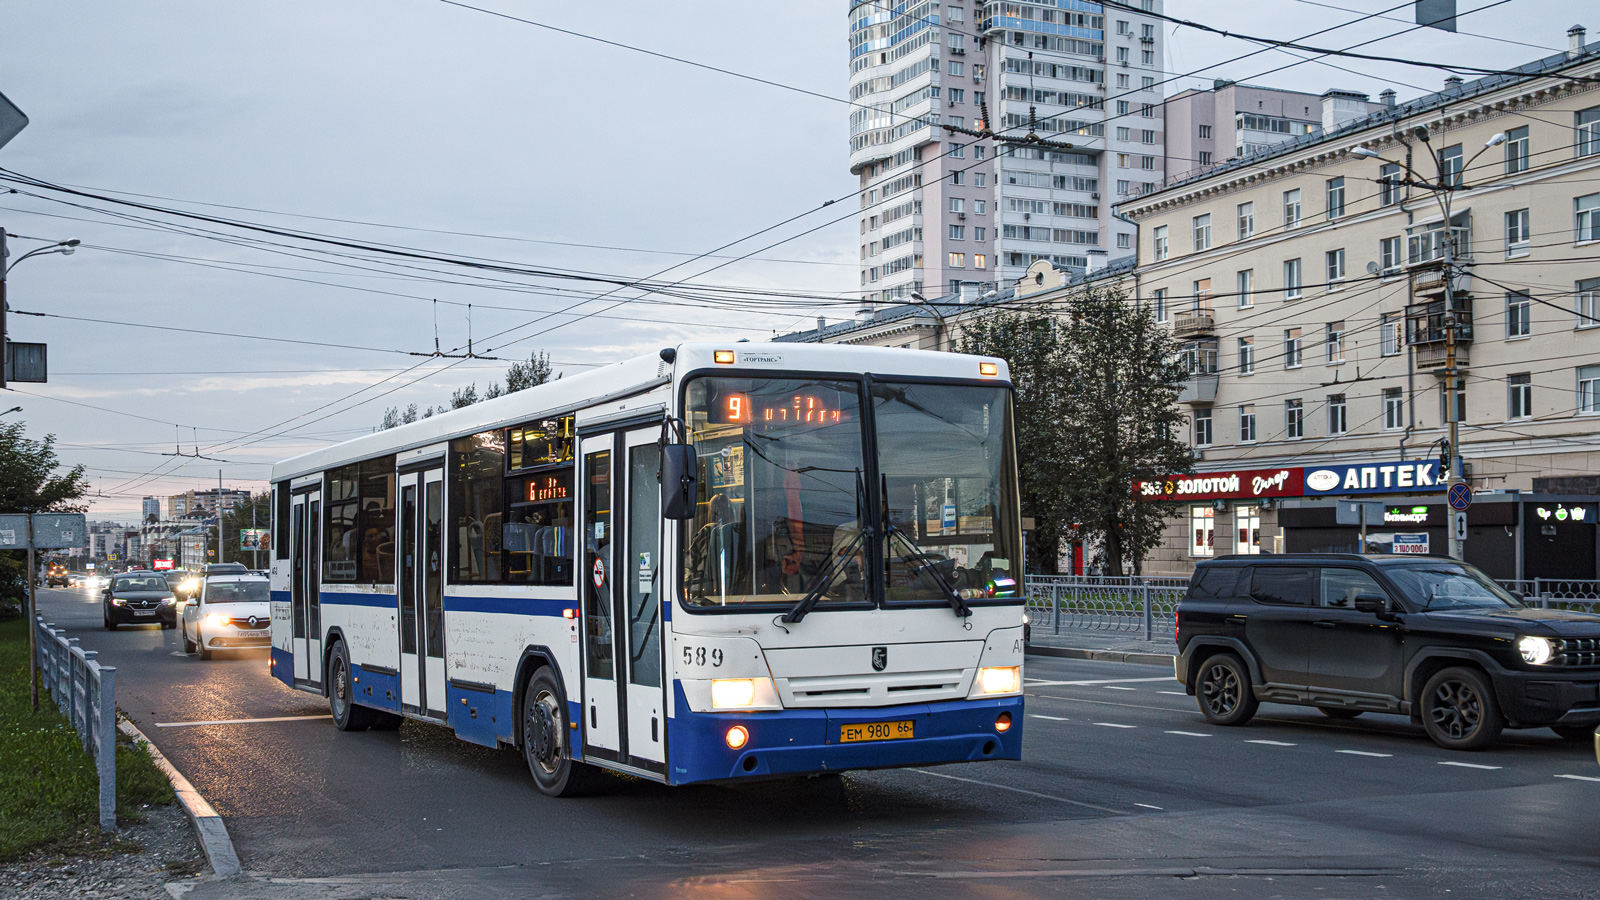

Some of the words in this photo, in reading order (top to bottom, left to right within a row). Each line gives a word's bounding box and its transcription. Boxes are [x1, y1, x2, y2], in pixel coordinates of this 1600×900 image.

[1176, 474, 1240, 495] ЗОЛОТОЙ
[683, 646, 724, 668] 589
[846, 728, 863, 740] ЕМ
[867, 723, 890, 739] 980
[897, 721, 909, 733] 66
